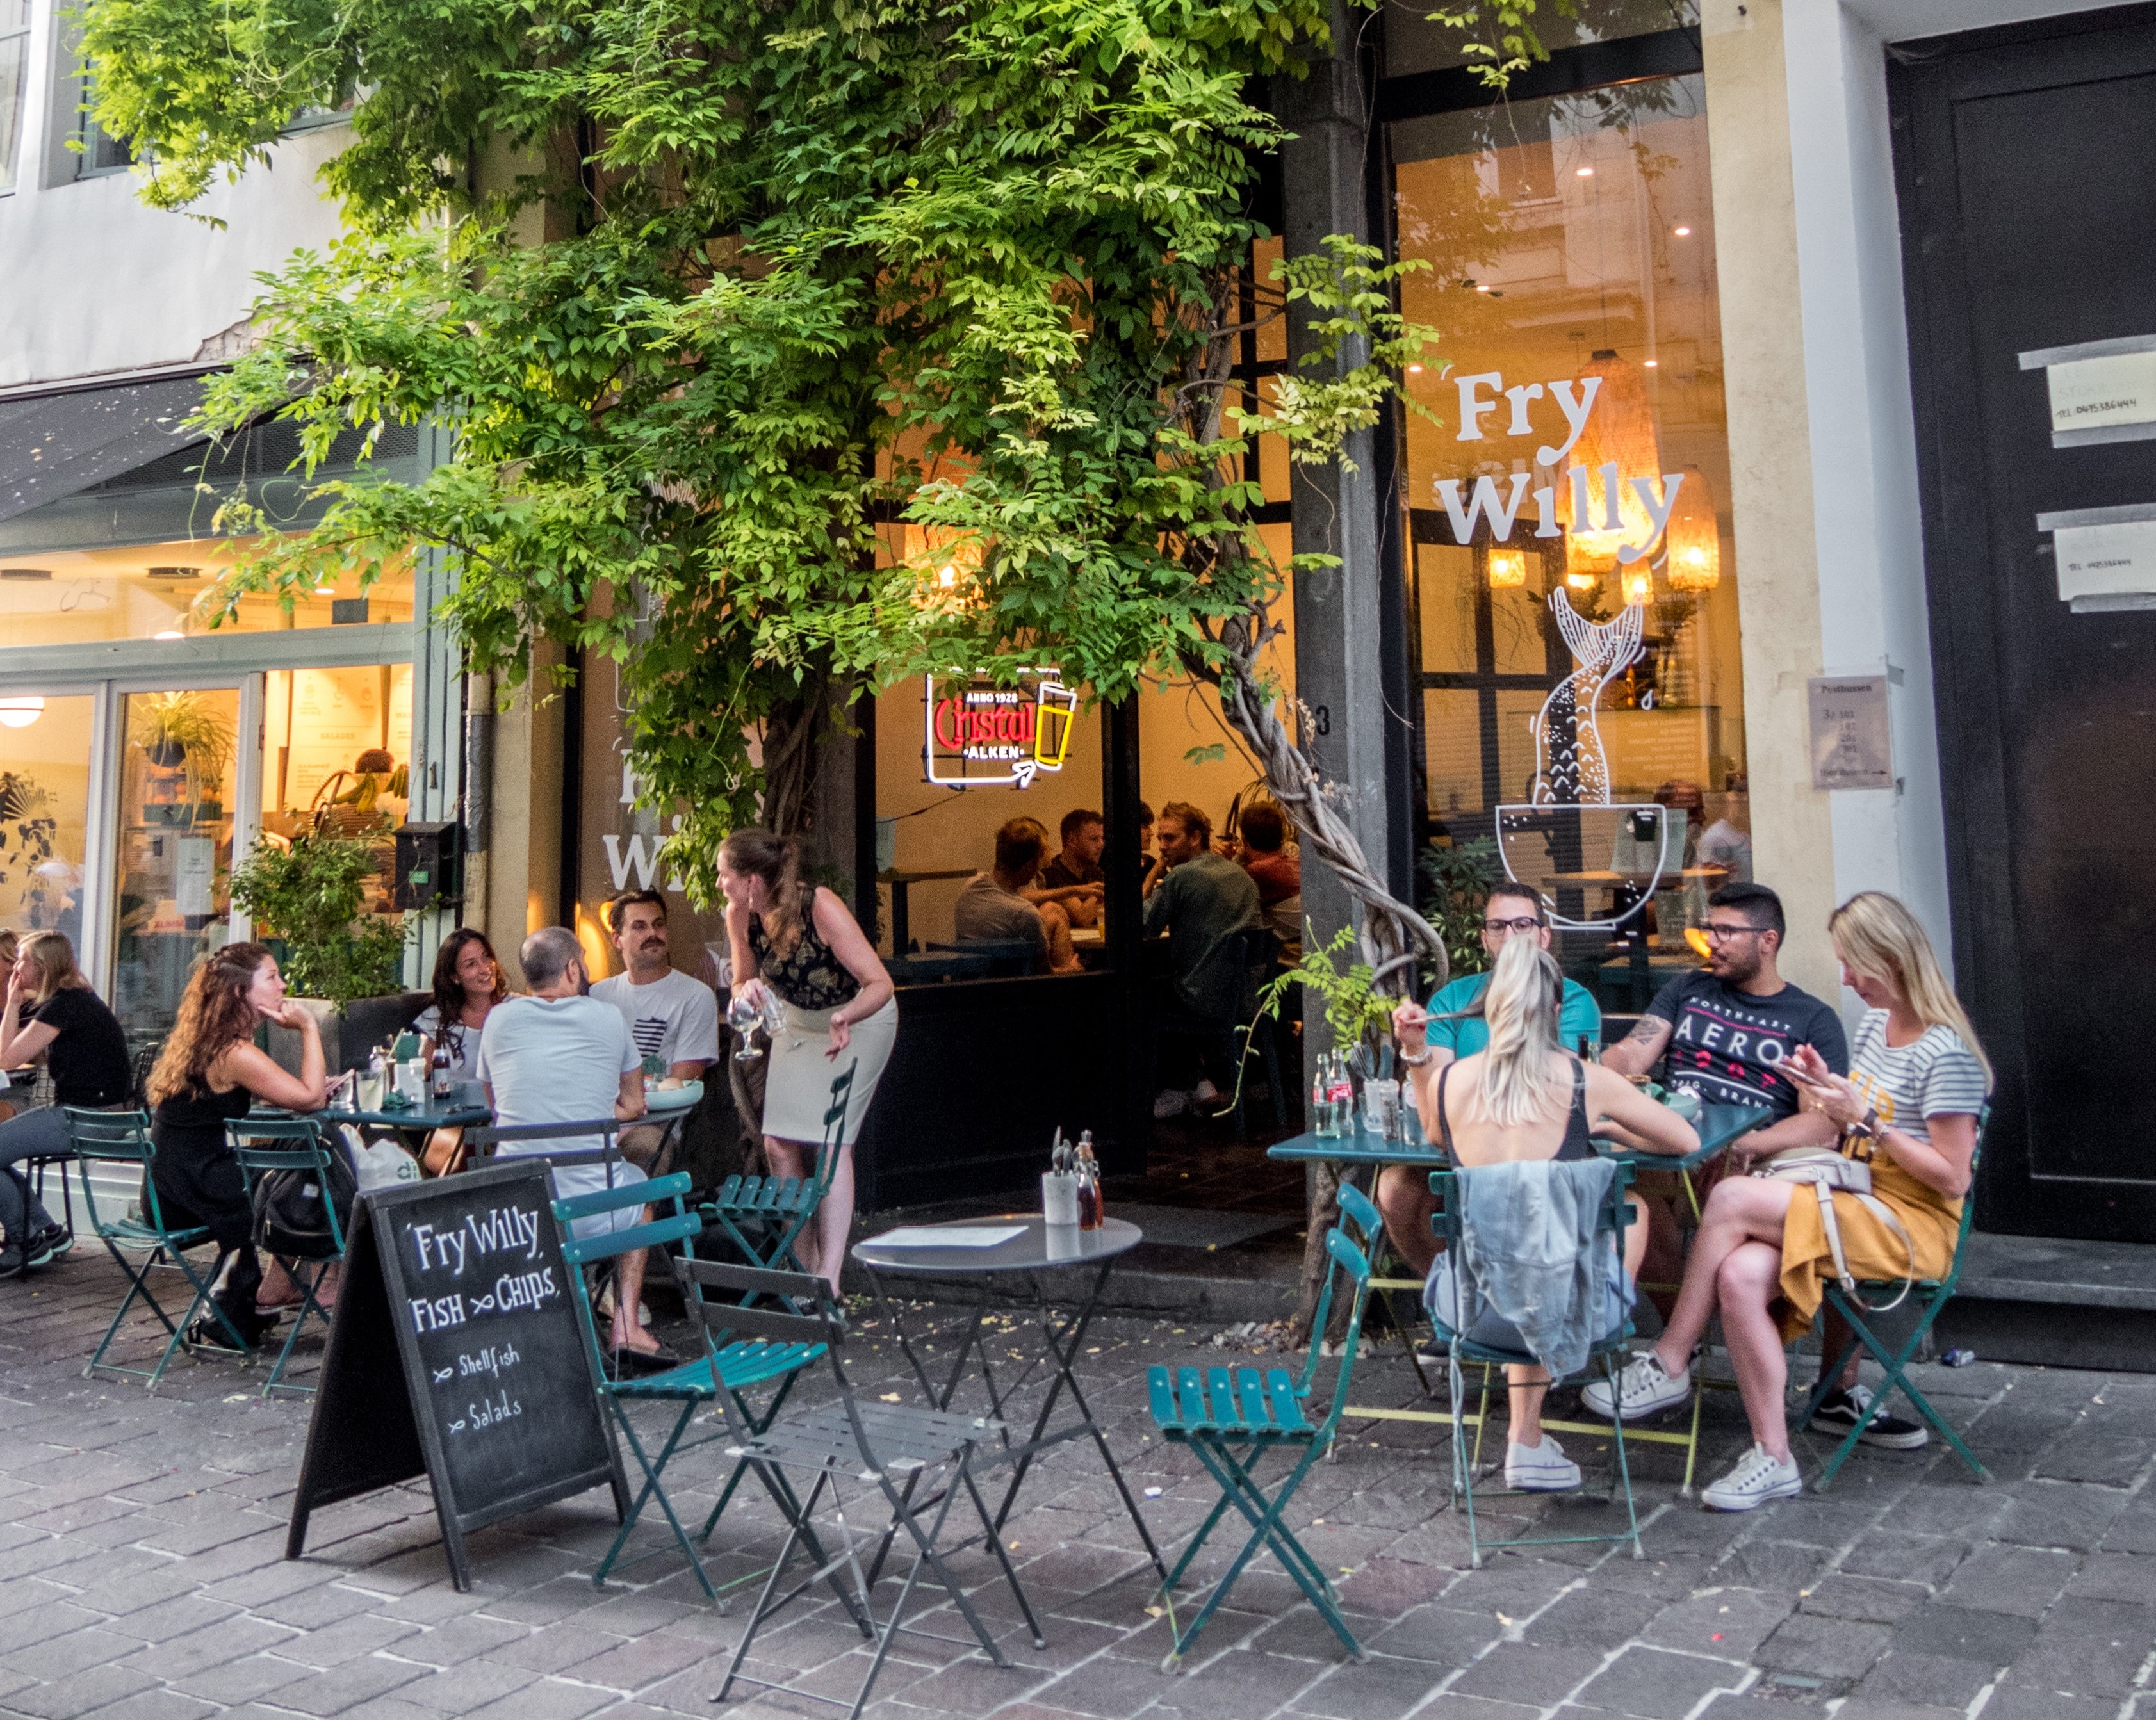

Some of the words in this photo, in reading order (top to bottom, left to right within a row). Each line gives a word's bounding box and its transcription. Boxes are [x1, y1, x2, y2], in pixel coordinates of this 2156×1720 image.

[1454, 371, 1602, 466] Fry
[1434, 462, 1684, 564] Willy
[967, 692, 993, 703] ANNO
[995, 692, 1018, 703] 1928
[1316, 705, 1330, 736] 3
[935, 698, 1036, 750] Cristal
[1689, 996, 1791, 1031] NORTHEAST
[1674, 1014, 1784, 1064] AERO
[414, 1223, 466, 1275] Fry
[466, 1205, 538, 1259] Willy
[412, 1294, 466, 1333] FISH
[496, 1266, 555, 1311] CHIPS
[459, 1342, 519, 1378] Shellfish
[470, 1388, 521, 1430] Salads
